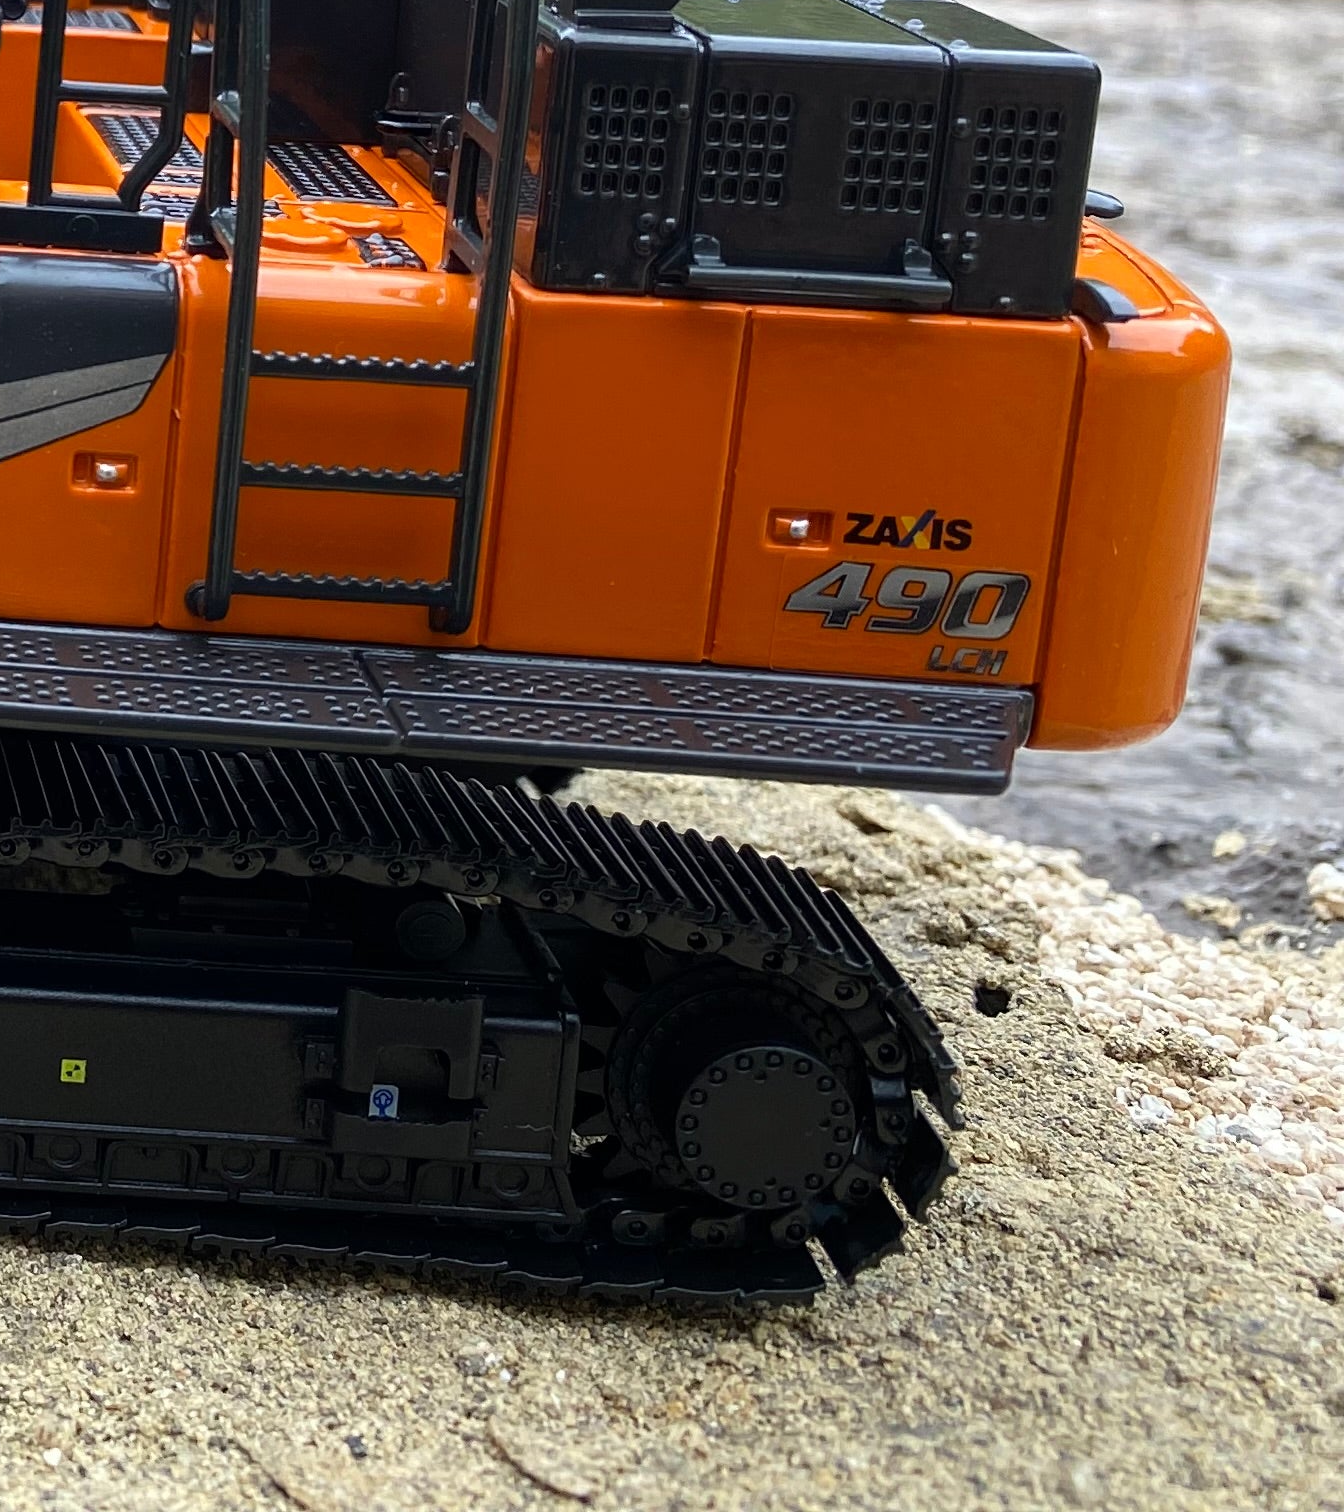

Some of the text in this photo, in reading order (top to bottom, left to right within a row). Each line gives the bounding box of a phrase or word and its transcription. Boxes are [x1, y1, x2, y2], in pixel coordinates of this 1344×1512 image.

[843, 509, 973, 551] ZAXIS
[783, 560, 1031, 640] 490
[926, 645, 1009, 676] LCH
